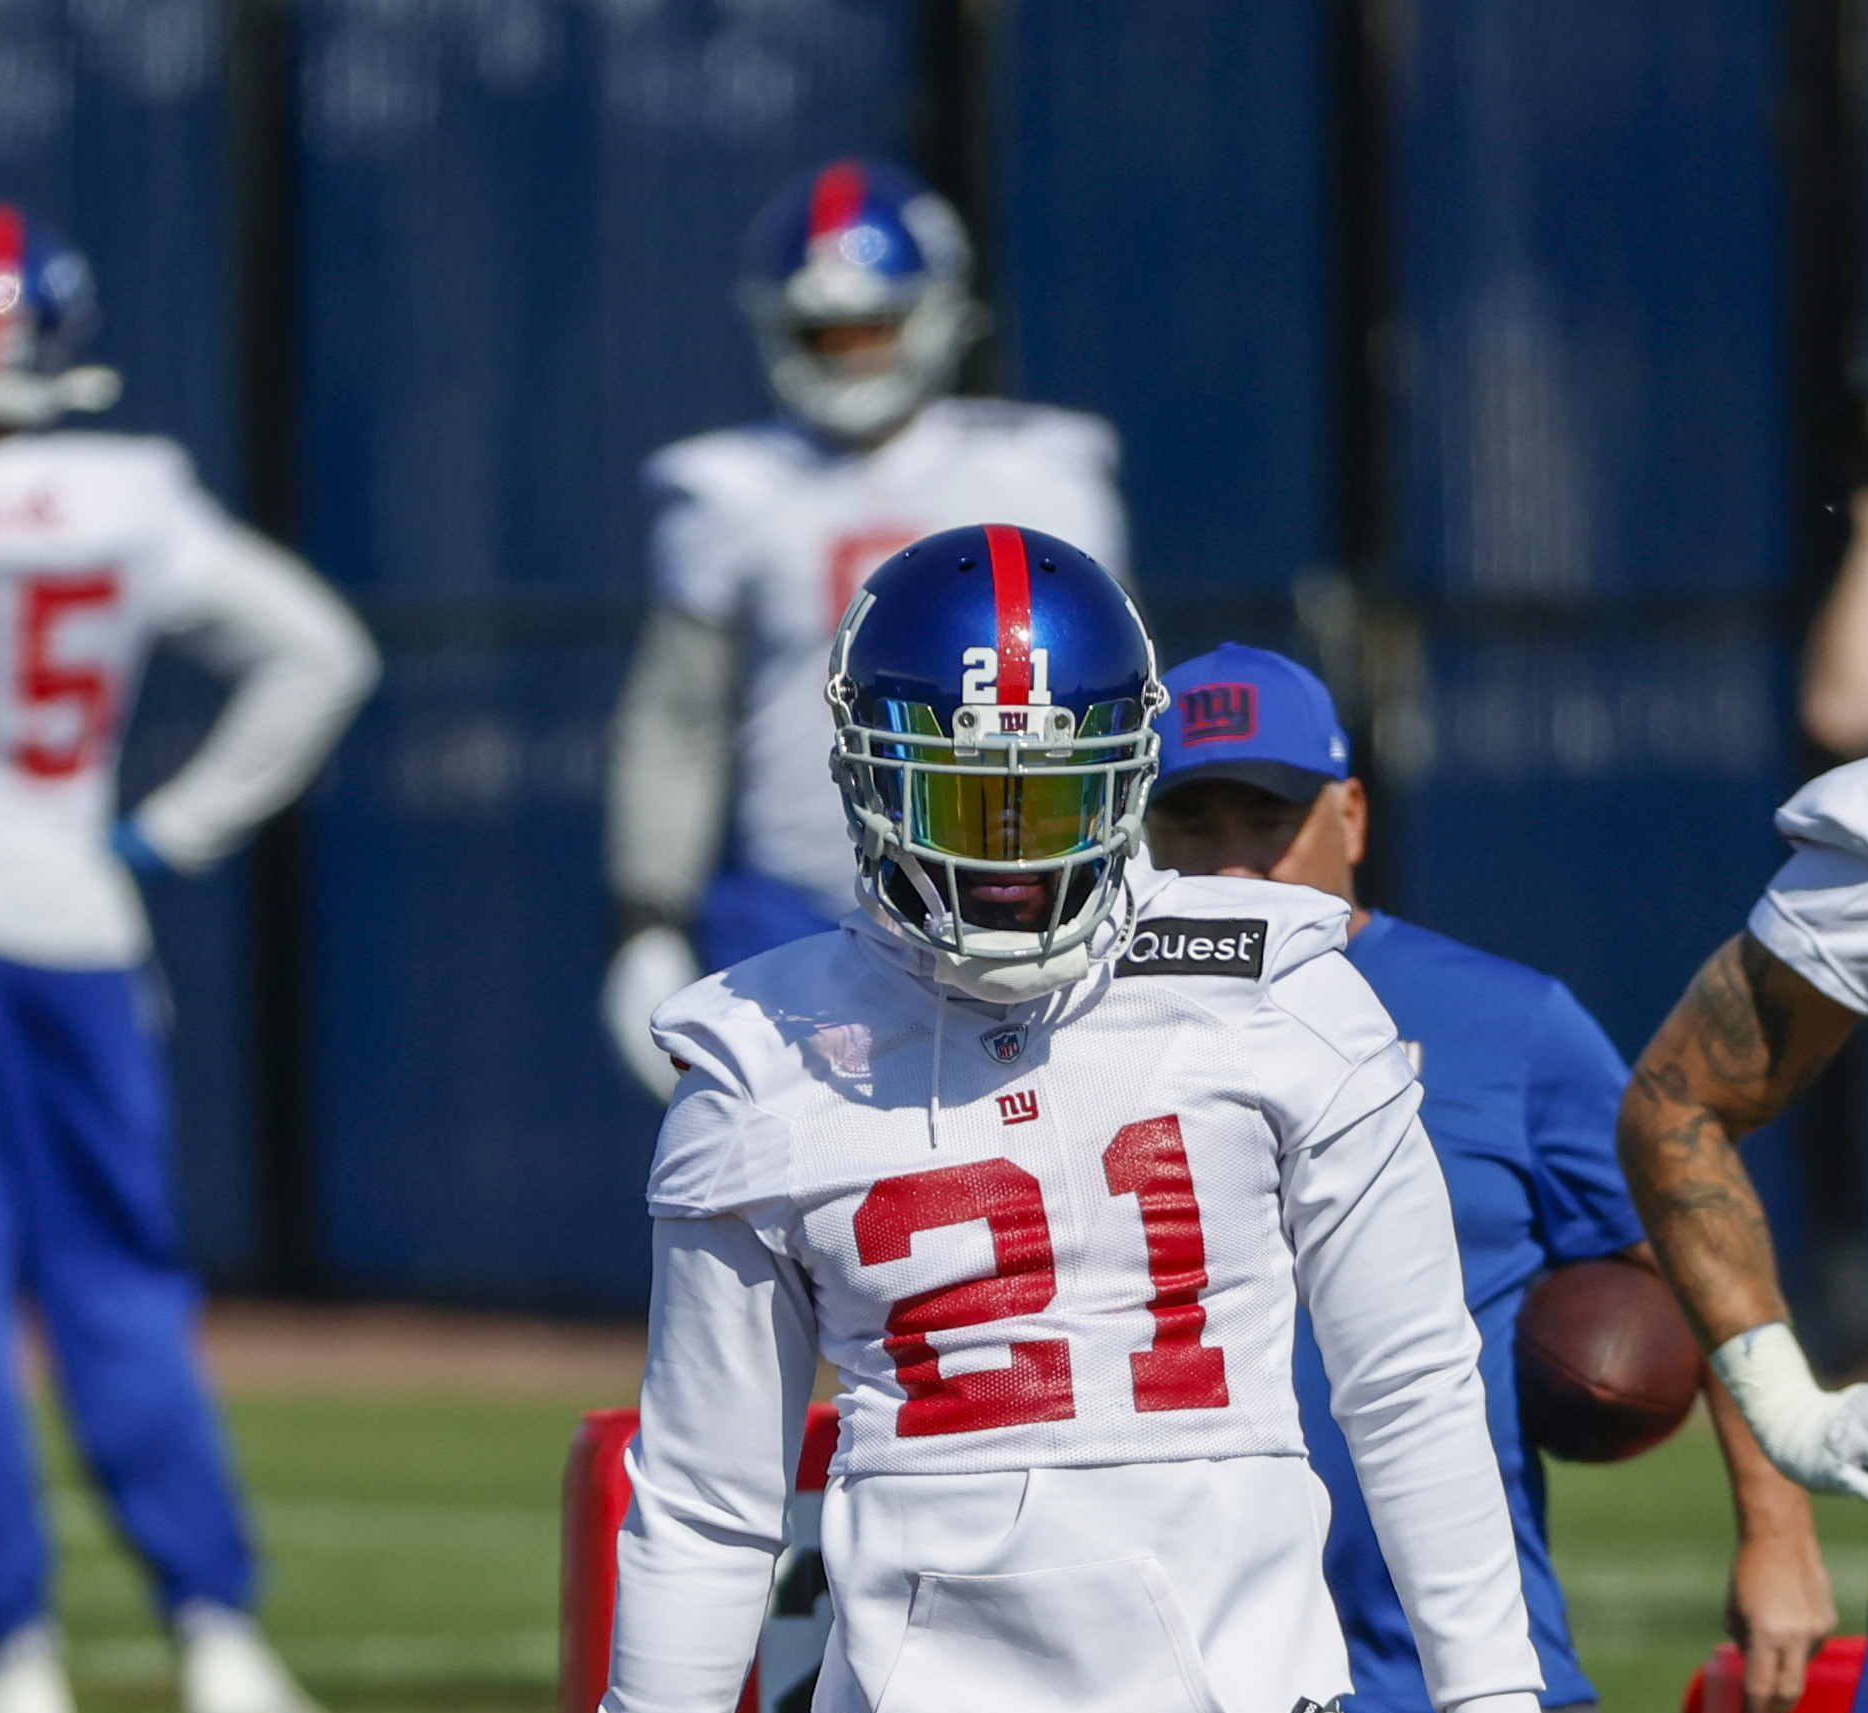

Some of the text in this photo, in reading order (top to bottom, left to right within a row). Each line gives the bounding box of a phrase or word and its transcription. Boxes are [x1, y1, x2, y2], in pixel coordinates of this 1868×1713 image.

[962, 646, 1051, 705] 21
[1178, 681, 1258, 748] ny
[1126, 930, 1255, 963] Quest
[995, 1088, 1039, 1126] ny
[853, 1113, 1230, 1437] 21
